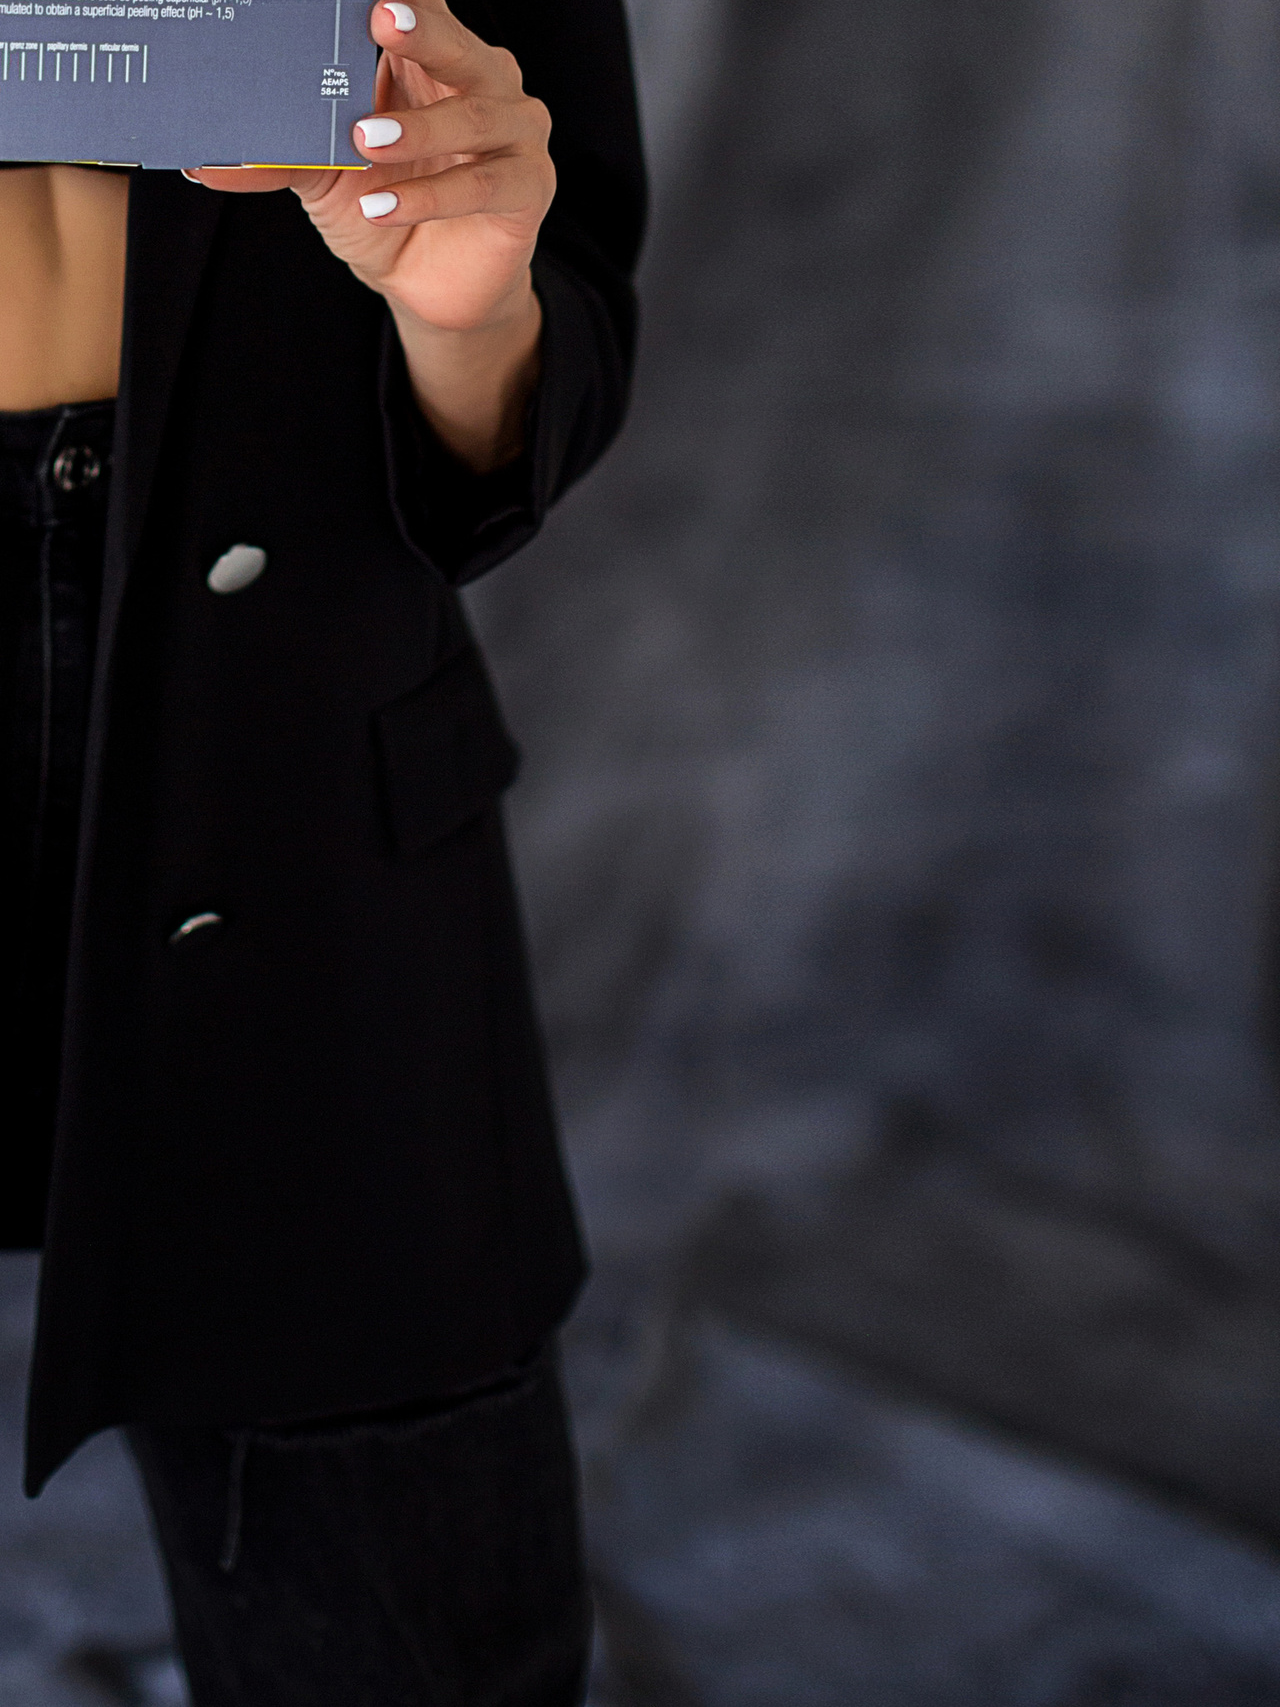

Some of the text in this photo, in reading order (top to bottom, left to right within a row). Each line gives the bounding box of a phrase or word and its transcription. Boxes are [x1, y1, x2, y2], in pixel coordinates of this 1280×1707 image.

[34, 3, 44, 15] to
[45, 3, 72, 16] obtain
[74, 7, 81, 16] a
[82, 4, 125, 19] superficial
[127, 5, 159, 20] peeling
[160, 5, 185, 18] effect
[187, 6, 203, 21] (pH
[216, 6, 235, 21] 1,5)
[321, 78, 349, 87] AEMPS
